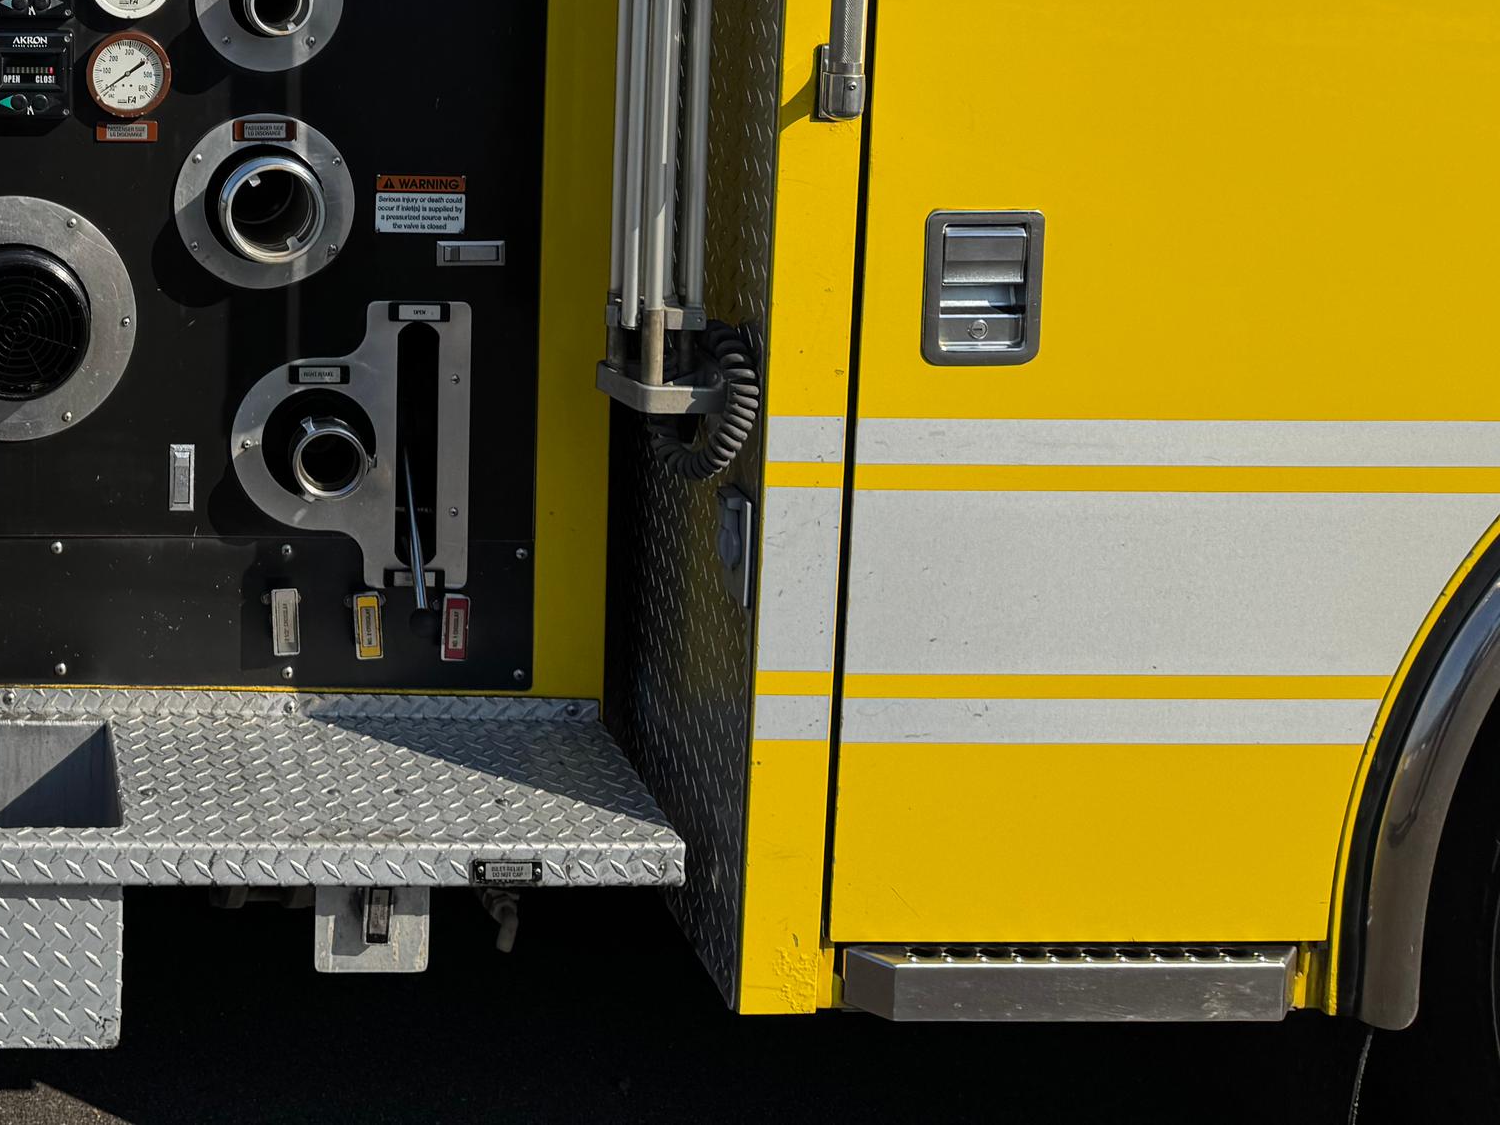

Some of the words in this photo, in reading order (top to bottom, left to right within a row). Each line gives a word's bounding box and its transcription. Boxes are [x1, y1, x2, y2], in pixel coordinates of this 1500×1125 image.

[12, 36, 48, 44] AKRON
[4, 75, 20, 83] OPEN
[398, 179, 460, 189] WARNING
[378, 195, 400, 203] Serious
[402, 195, 418, 203] injury
[428, 205, 454, 213] supplied
